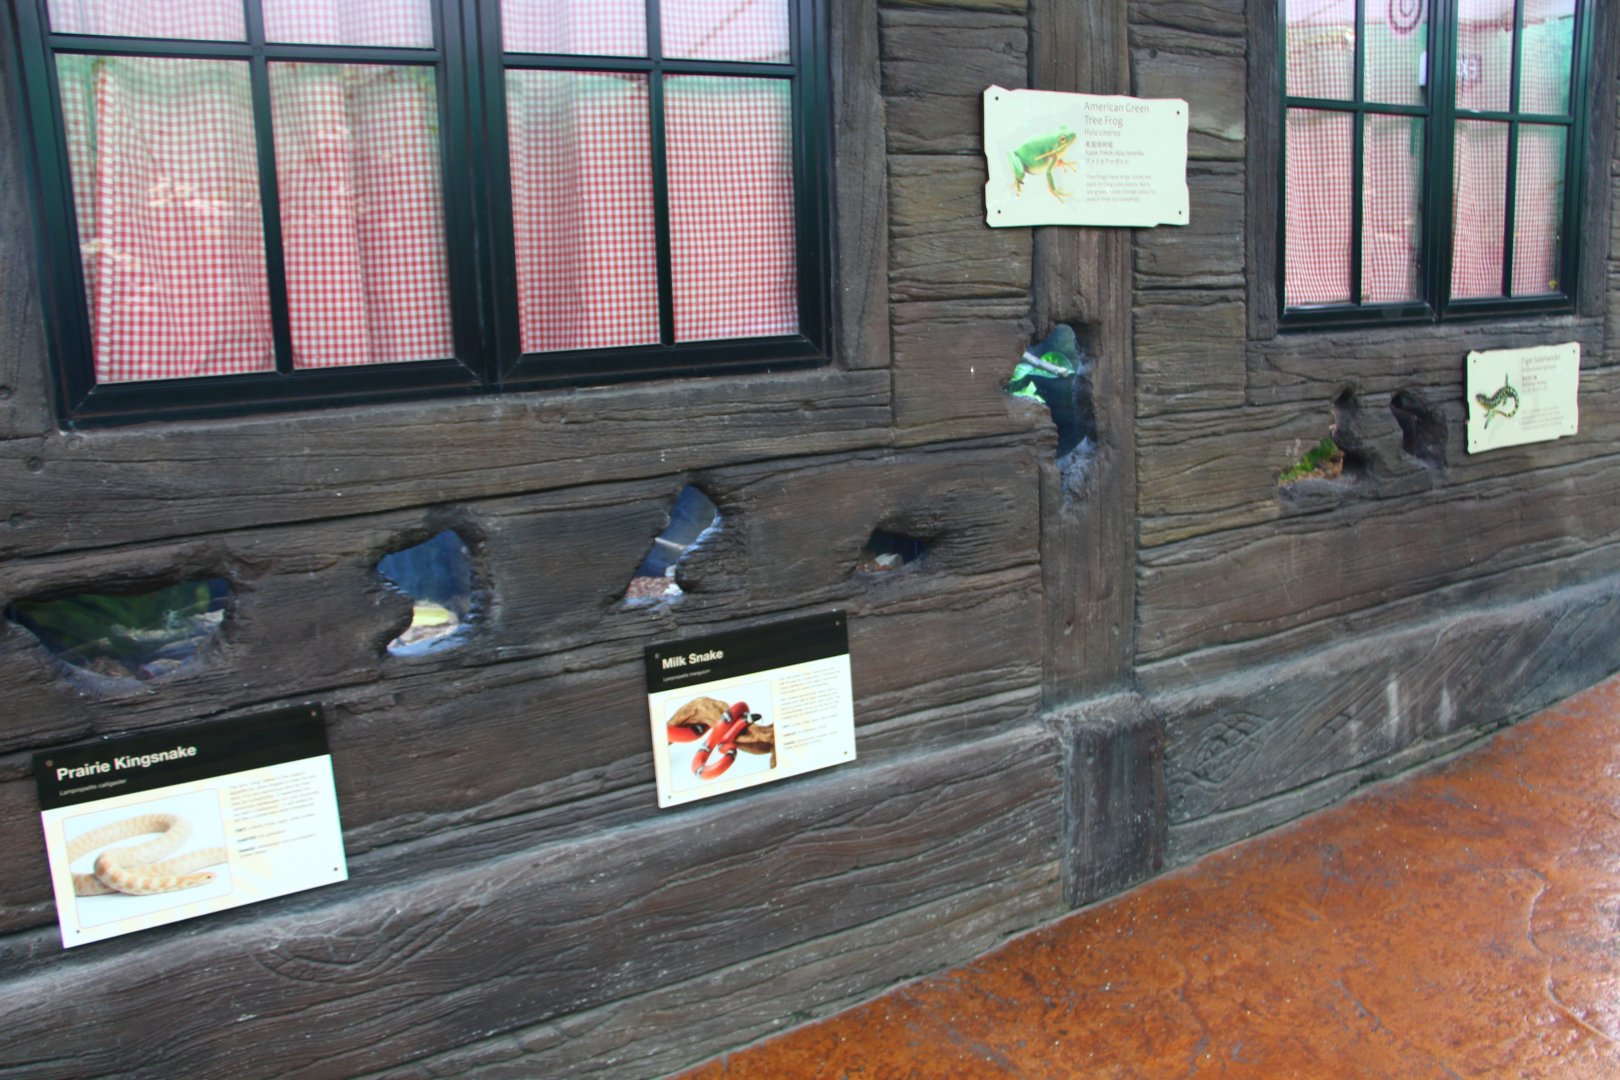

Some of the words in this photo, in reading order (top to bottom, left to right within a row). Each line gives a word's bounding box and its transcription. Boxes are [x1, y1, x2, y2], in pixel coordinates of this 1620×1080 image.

[1084, 102, 1124, 113] American
[1126, 103, 1150, 113] Green
[1084, 115, 1103, 125] Tree
[1105, 115, 1123, 128] Frog
[661, 655, 687, 670] Milk
[688, 649, 724, 665] Snake
[56, 761, 111, 781] Prairie
[113, 745, 197, 770] Kingsnake
